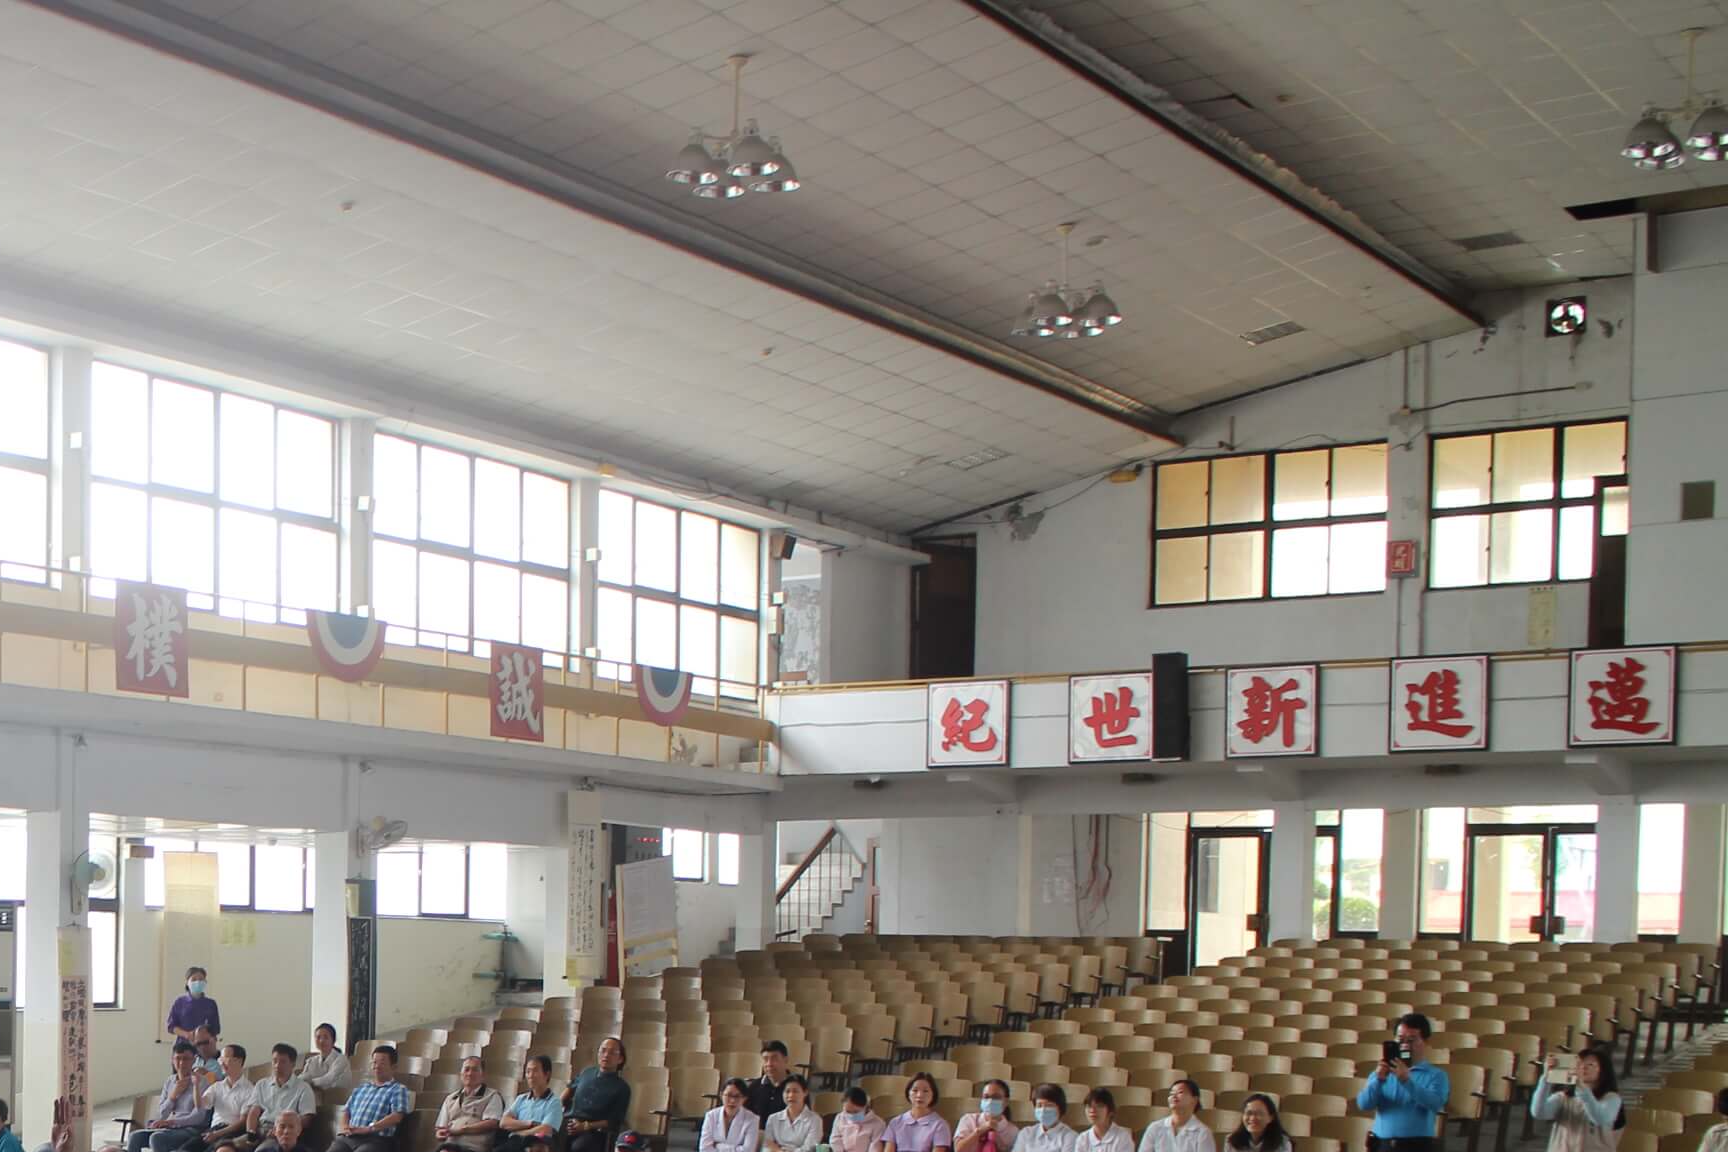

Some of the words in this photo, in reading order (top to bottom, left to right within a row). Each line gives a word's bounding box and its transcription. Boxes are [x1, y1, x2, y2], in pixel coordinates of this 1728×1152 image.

[125, 592, 182, 689] 樸
[496, 654, 540, 734] 誠
[940, 697, 998, 753] 紀
[1083, 686, 1140, 748] 世
[1236, 675, 1308, 748] 新
[1406, 669, 1474, 739] 進
[1589, 657, 1660, 739] 邁
